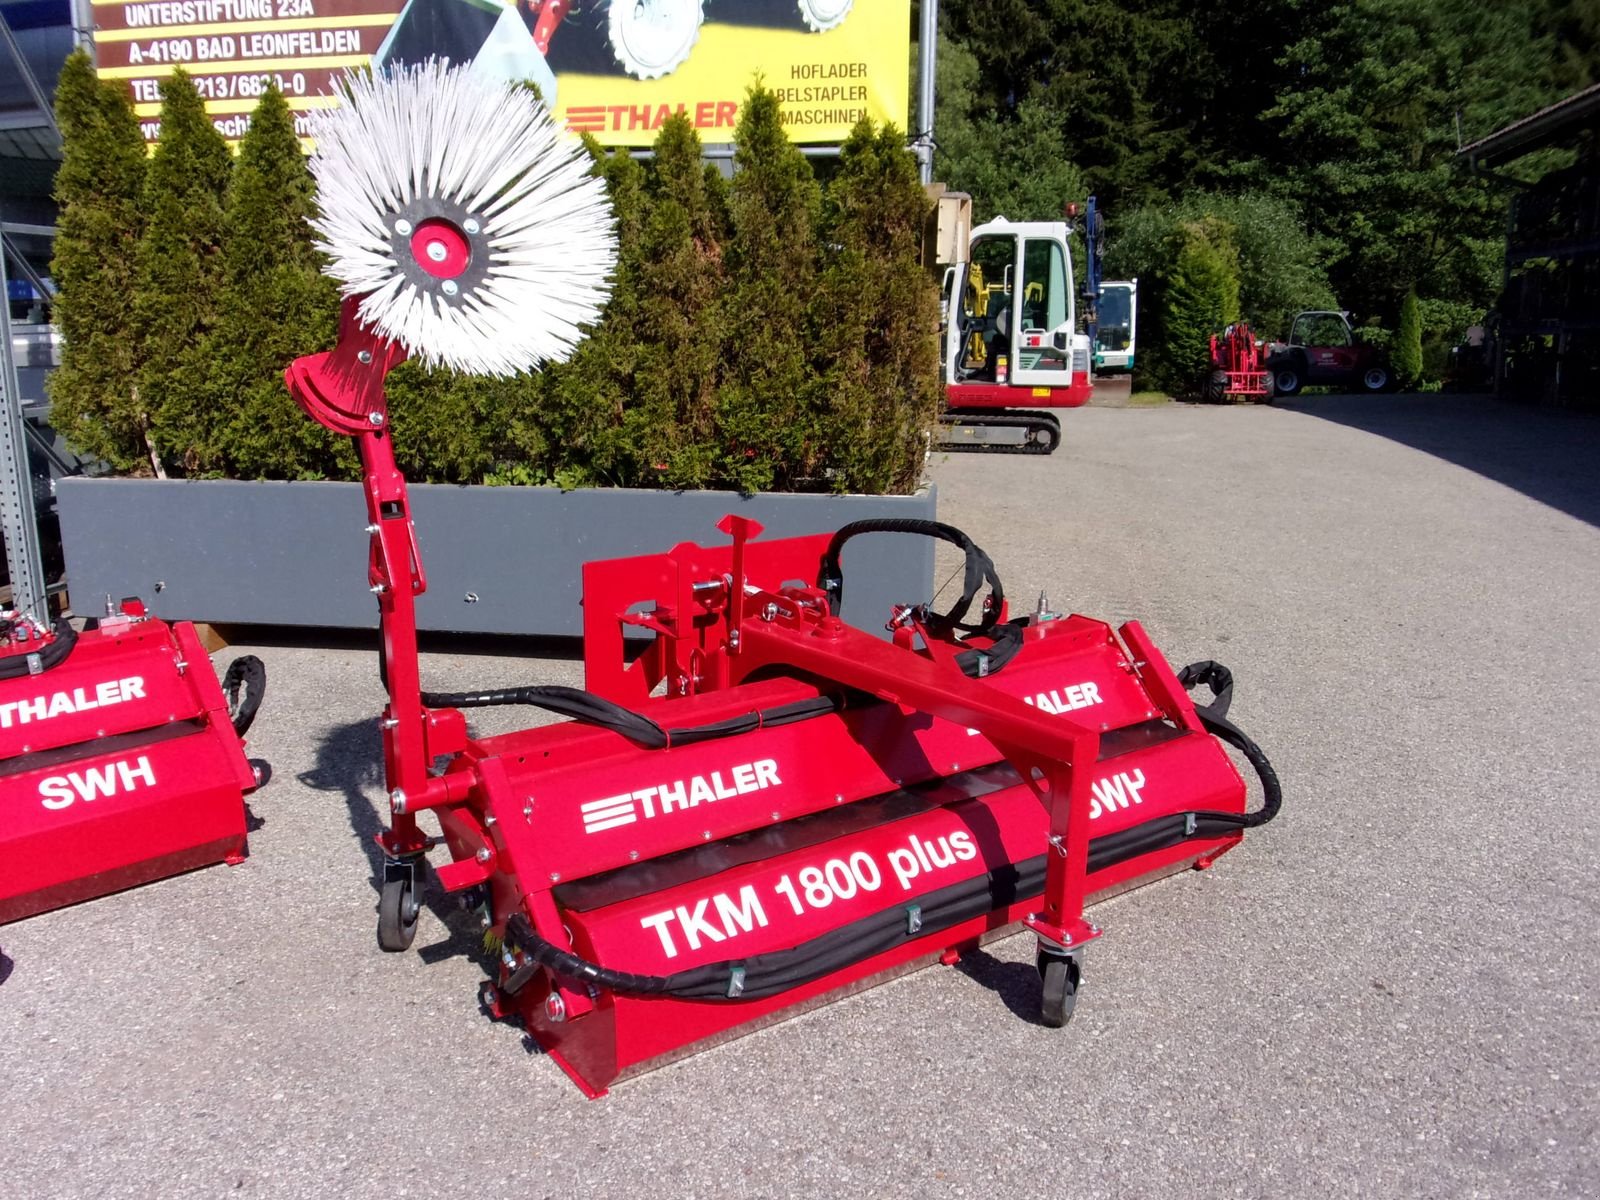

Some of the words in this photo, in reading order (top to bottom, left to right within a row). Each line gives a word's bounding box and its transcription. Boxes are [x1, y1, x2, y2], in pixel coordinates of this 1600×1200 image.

[125, 0, 273, 27] UNTERSTIFTUNG
[278, 0, 314, 17] 23A
[129, 41, 192, 63] A-4190
[197, 37, 235, 58] BAD
[240, 30, 360, 56] LEONFELDEN
[791, 63, 867, 79] HOFLADER
[769, 86, 867, 102] ABELSTAPLER
[607, 102, 738, 131] THALER
[0, 676, 146, 728] THALER
[38, 756, 156, 810] SWH
[632, 758, 781, 819] THALER
[640, 884, 769, 959] TKM
[774, 851, 882, 916] 1800
[888, 829, 978, 890] plus
